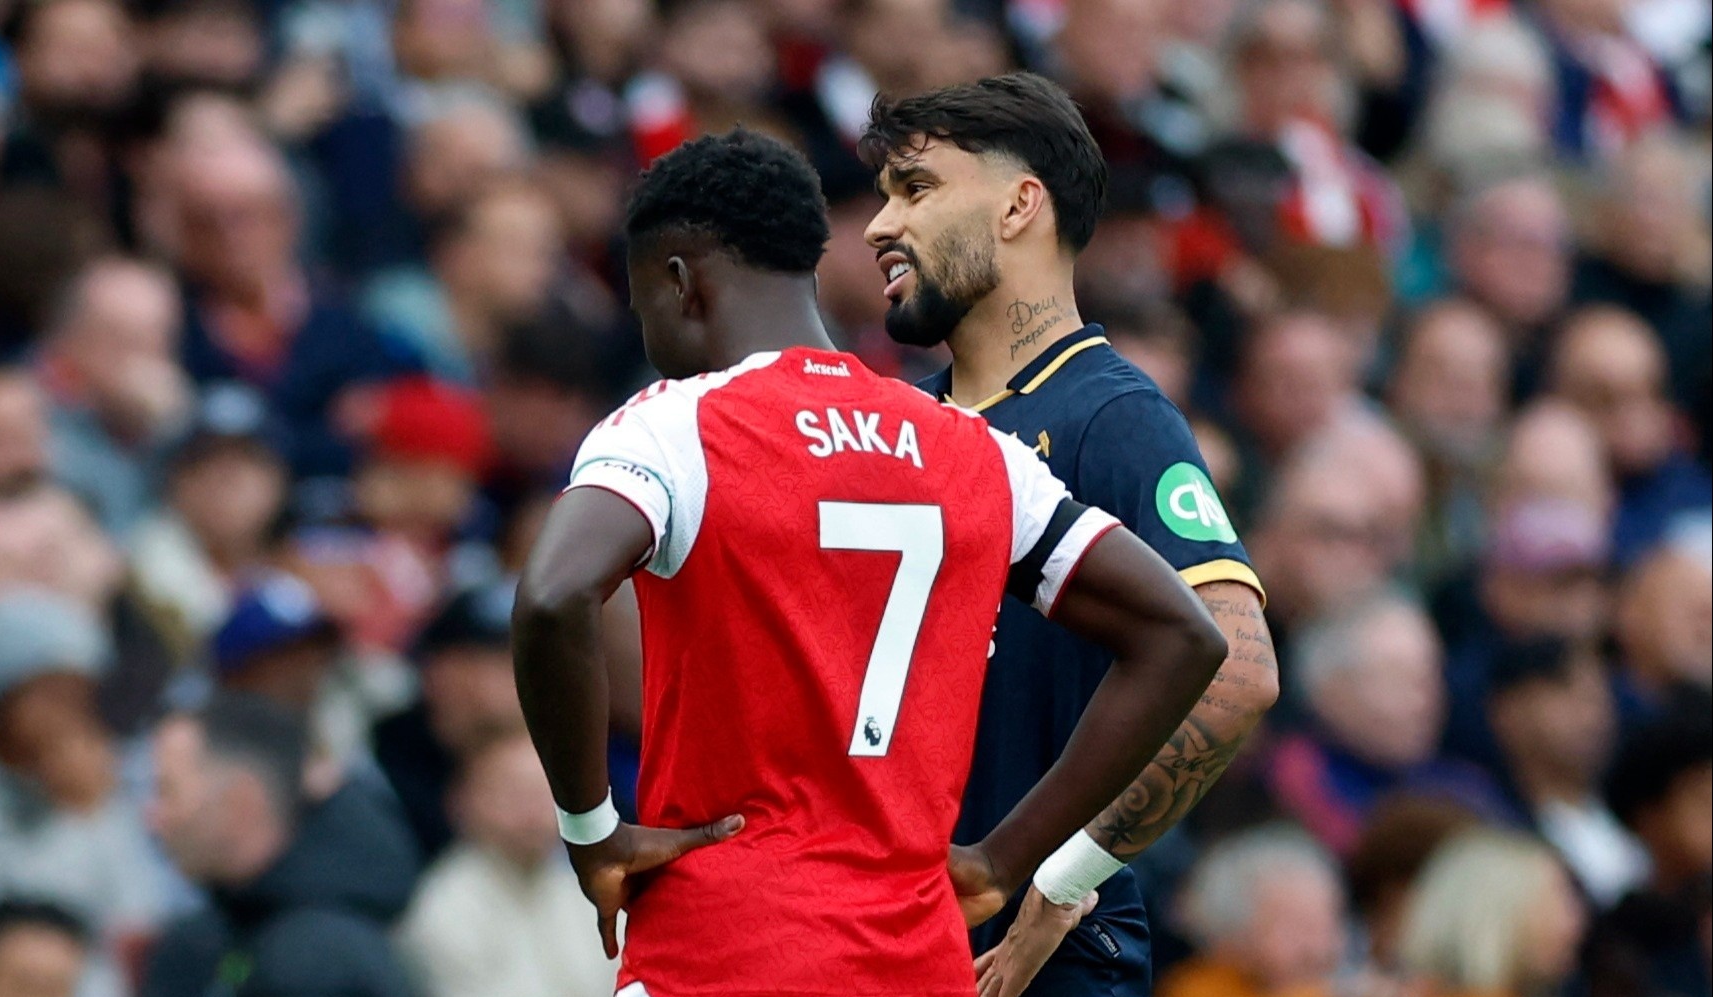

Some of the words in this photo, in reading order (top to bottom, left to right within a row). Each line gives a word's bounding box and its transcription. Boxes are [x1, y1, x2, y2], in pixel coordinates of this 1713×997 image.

[803, 358, 851, 377] Arsenal
[795, 407, 923, 468] SAKA
[817, 501, 944, 757] 7
